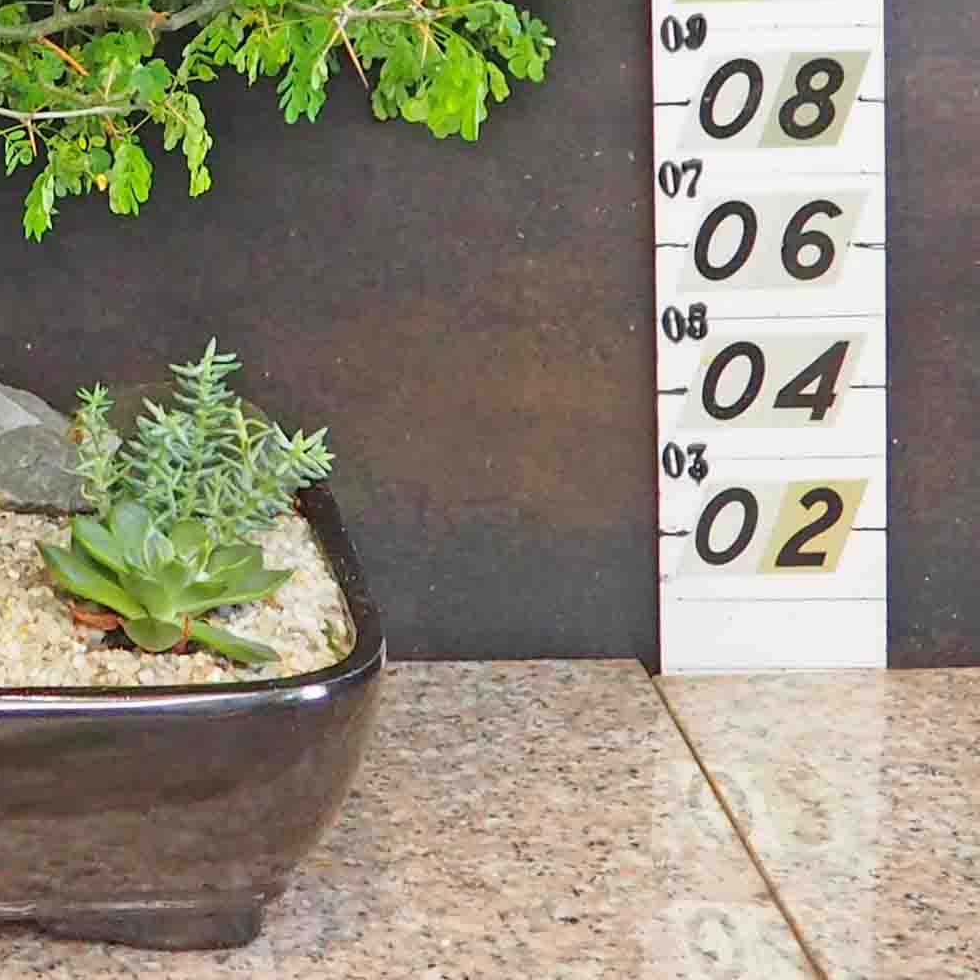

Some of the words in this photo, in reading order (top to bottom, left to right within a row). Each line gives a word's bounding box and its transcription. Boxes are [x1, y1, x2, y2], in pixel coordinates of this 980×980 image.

[660, 13, 707, 53] 09
[699, 58, 845, 139] 08
[658, 158, 703, 198] 07
[694, 199, 843, 281] 06
[702, 340, 850, 420] 04
[662, 441, 709, 486] 03
[695, 487, 844, 568] 02
